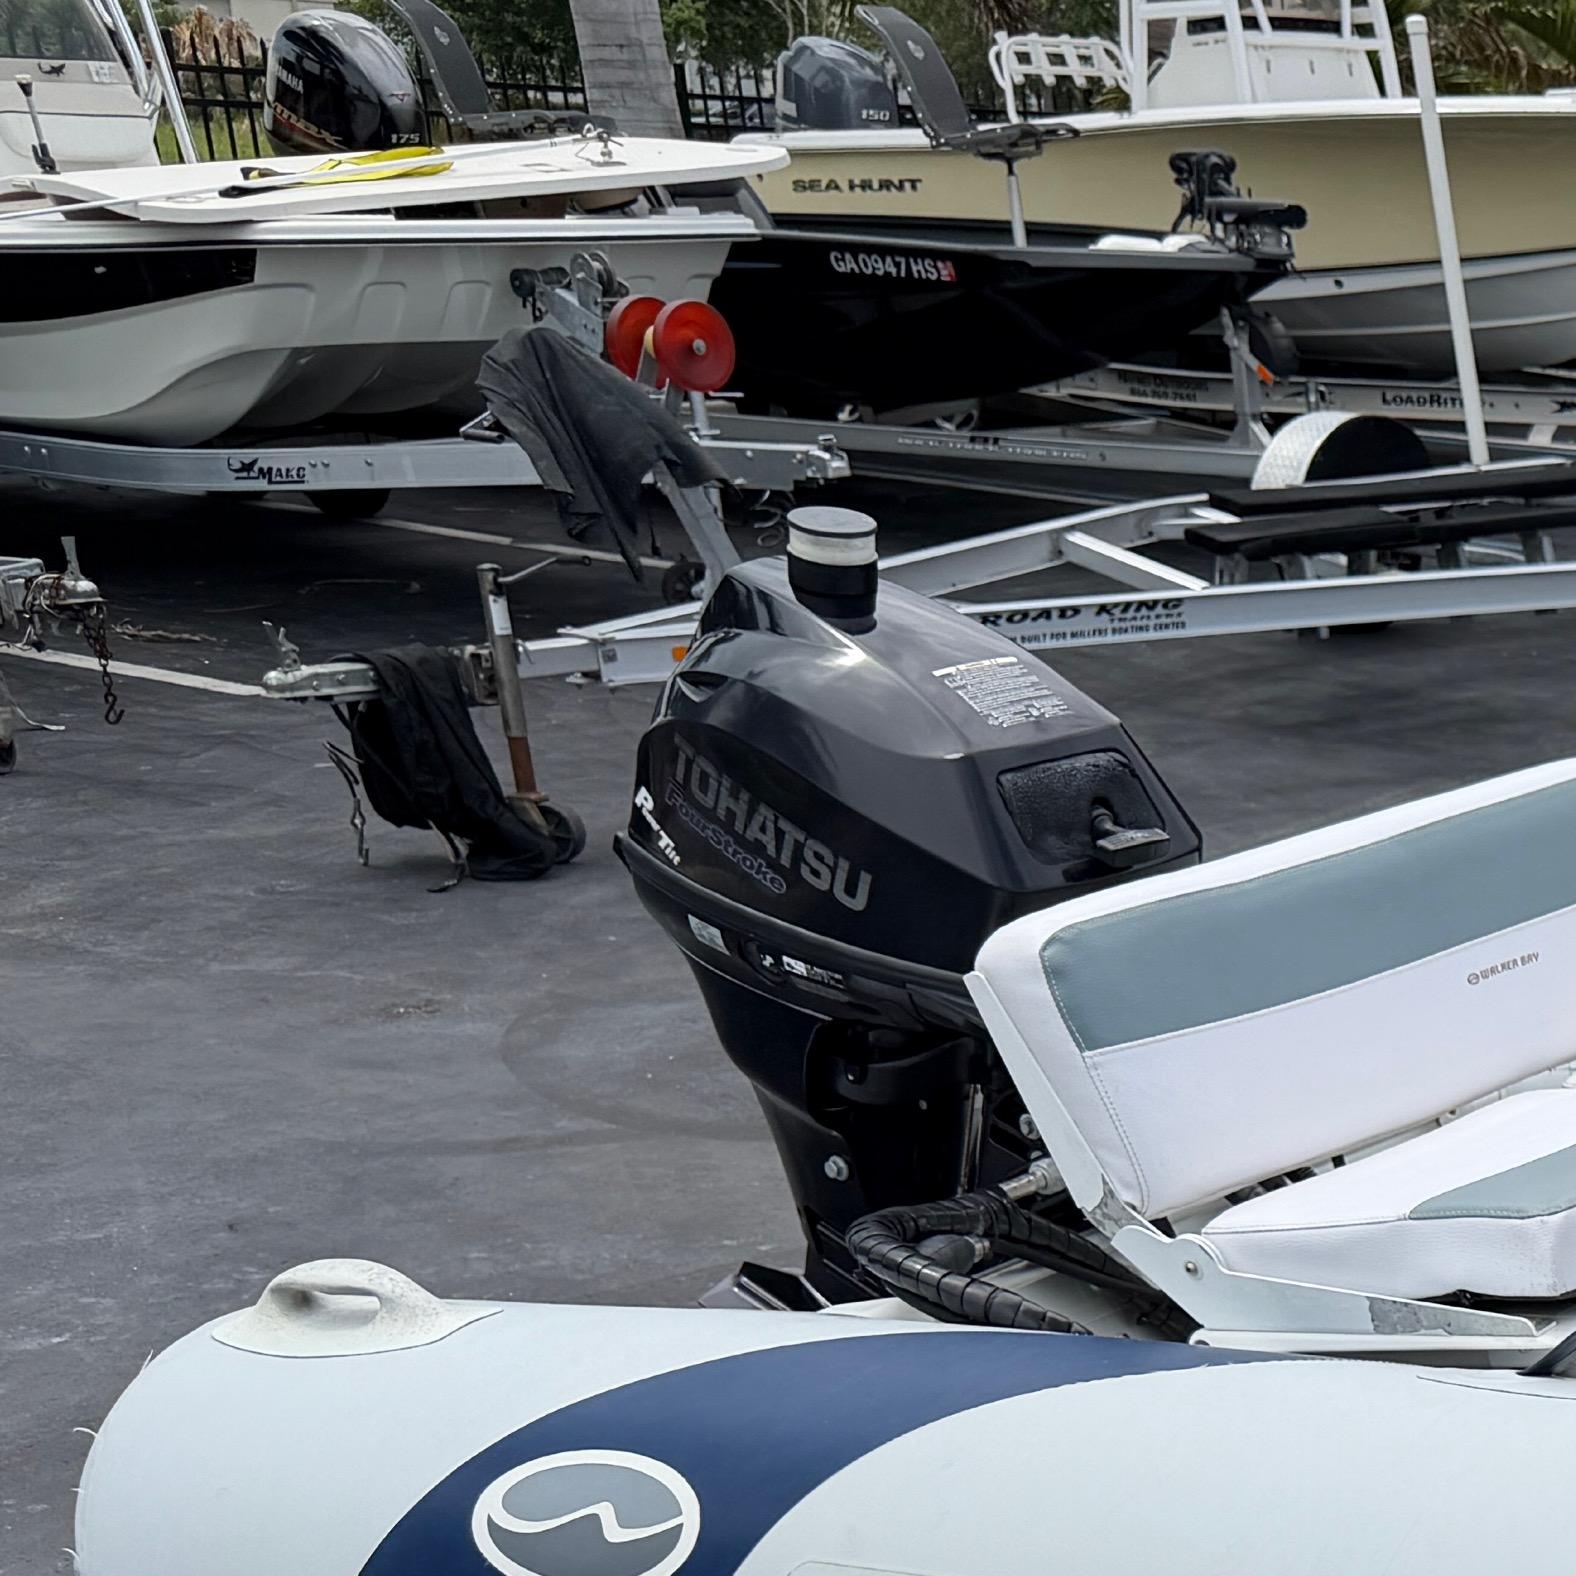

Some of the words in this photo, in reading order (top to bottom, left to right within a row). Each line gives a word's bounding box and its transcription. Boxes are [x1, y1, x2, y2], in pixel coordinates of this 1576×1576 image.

[276, 64, 304, 95] AMAHA
[861, 109, 890, 121] 150
[391, 133, 420, 144] 175
[792, 179, 844, 193] SEA
[848, 178, 922, 193] HUNT
[1381, 391, 1464, 409] LOADRIT
[979, 606, 1081, 627] ROAD
[1095, 599, 1185, 617] KING
[1020, 632, 1048, 644] BUILT
[1050, 630, 1068, 642] FOR
[1111, 623, 1150, 636] BOATING
[1152, 620, 1187, 633] CENTER
[673, 731, 873, 912] TOHATSU
[1480, 958, 1519, 980] WALKER
[1519, 951, 1540, 967] BAY
